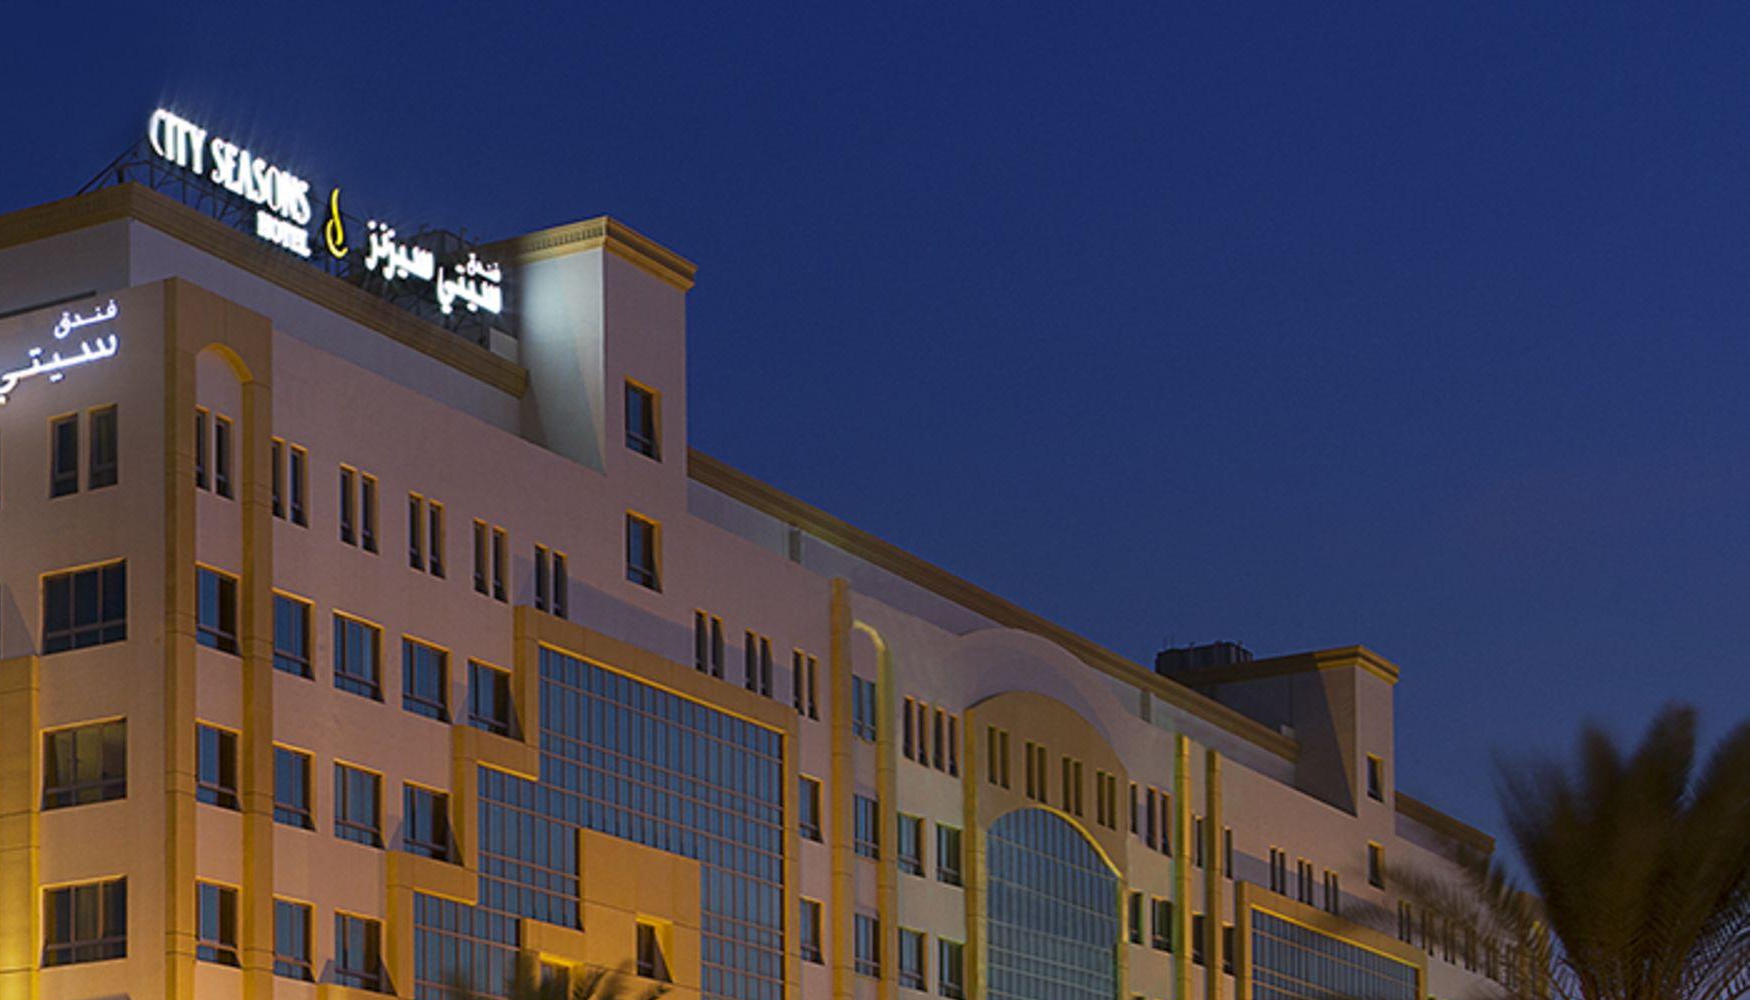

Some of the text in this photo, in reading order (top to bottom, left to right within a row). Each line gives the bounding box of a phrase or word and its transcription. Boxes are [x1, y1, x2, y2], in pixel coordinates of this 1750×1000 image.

[149, 108, 311, 225] CITY SEASONS
[256, 209, 312, 257] HOTEL
[365, 220, 435, 281] سيزنز
[53, 299, 118, 339] فندق
